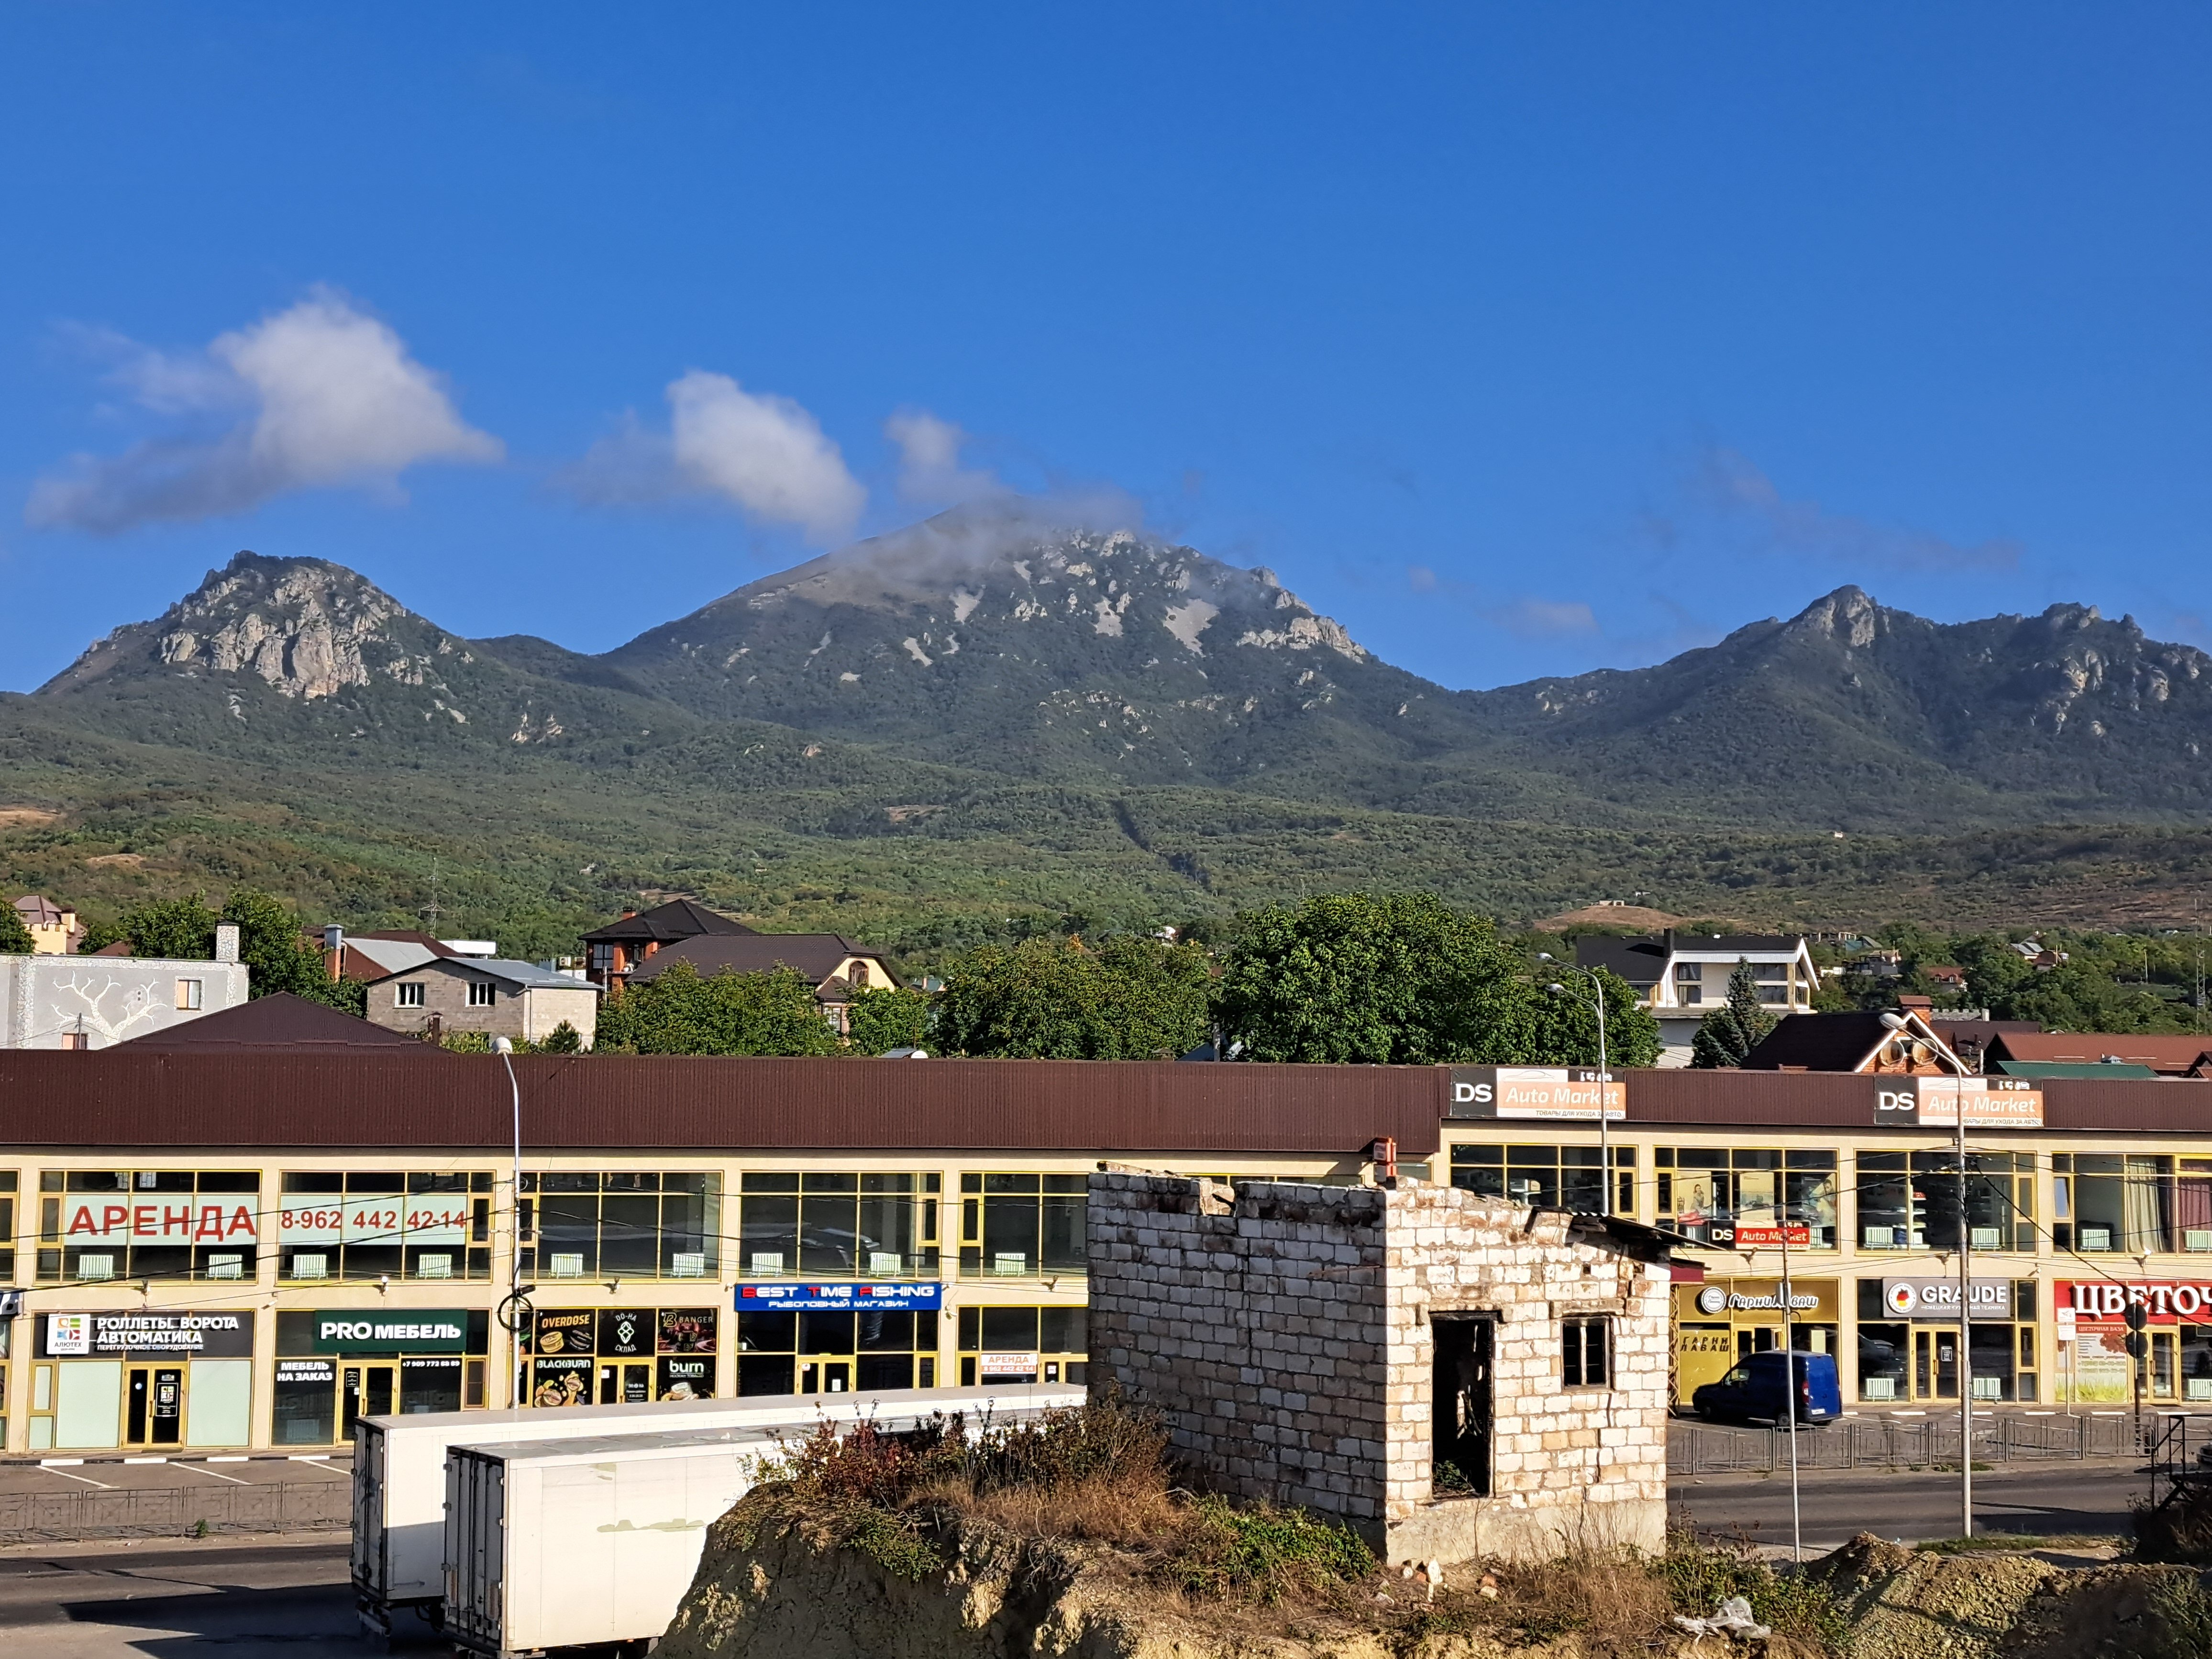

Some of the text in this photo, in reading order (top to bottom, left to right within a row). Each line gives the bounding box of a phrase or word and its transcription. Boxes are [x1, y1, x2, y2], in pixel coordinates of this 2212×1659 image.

[1455, 1083, 1493, 1102] DS
[1506, 1086, 1619, 1105] Auto Market
[1880, 1092, 1914, 1110] DS
[1928, 1095, 2036, 1113] Auto Market
[67, 1206, 257, 1242] АРЕНДА
[281, 1210, 466, 1229] 8-962 442 42-14
[1712, 1228, 1734, 1240] DS
[1741, 1231, 1807, 1241] Auto Maket
[742, 1286, 934, 1297] BEST TIME FISHING
[1921, 1285, 2007, 1303] GRAUDE
[768, 1298, 850, 1307] РЫБОЛОВНЫЙ
[180, 1316, 239, 1329] ВОРОТА
[542, 1314, 590, 1328] OVERDOSE
[679, 1316, 714, 1324] BANGER
[97, 1330, 203, 1344] АВТОМАТИКА
[321, 1322, 461, 1339] PRO МЕБЕЛЬ
[1683, 1337, 1729, 1345] ГАРНИ
[615, 1344, 637, 1353] СКЛАД
[281, 1362, 329, 1371] МЕБЕЛЬ
[537, 1359, 591, 1368] BLACKBURN
[669, 1359, 704, 1373] burn
[988, 1356, 1029, 1364] АРЕНДА
[277, 1372, 332, 1381] НА ЗАКАЗ
